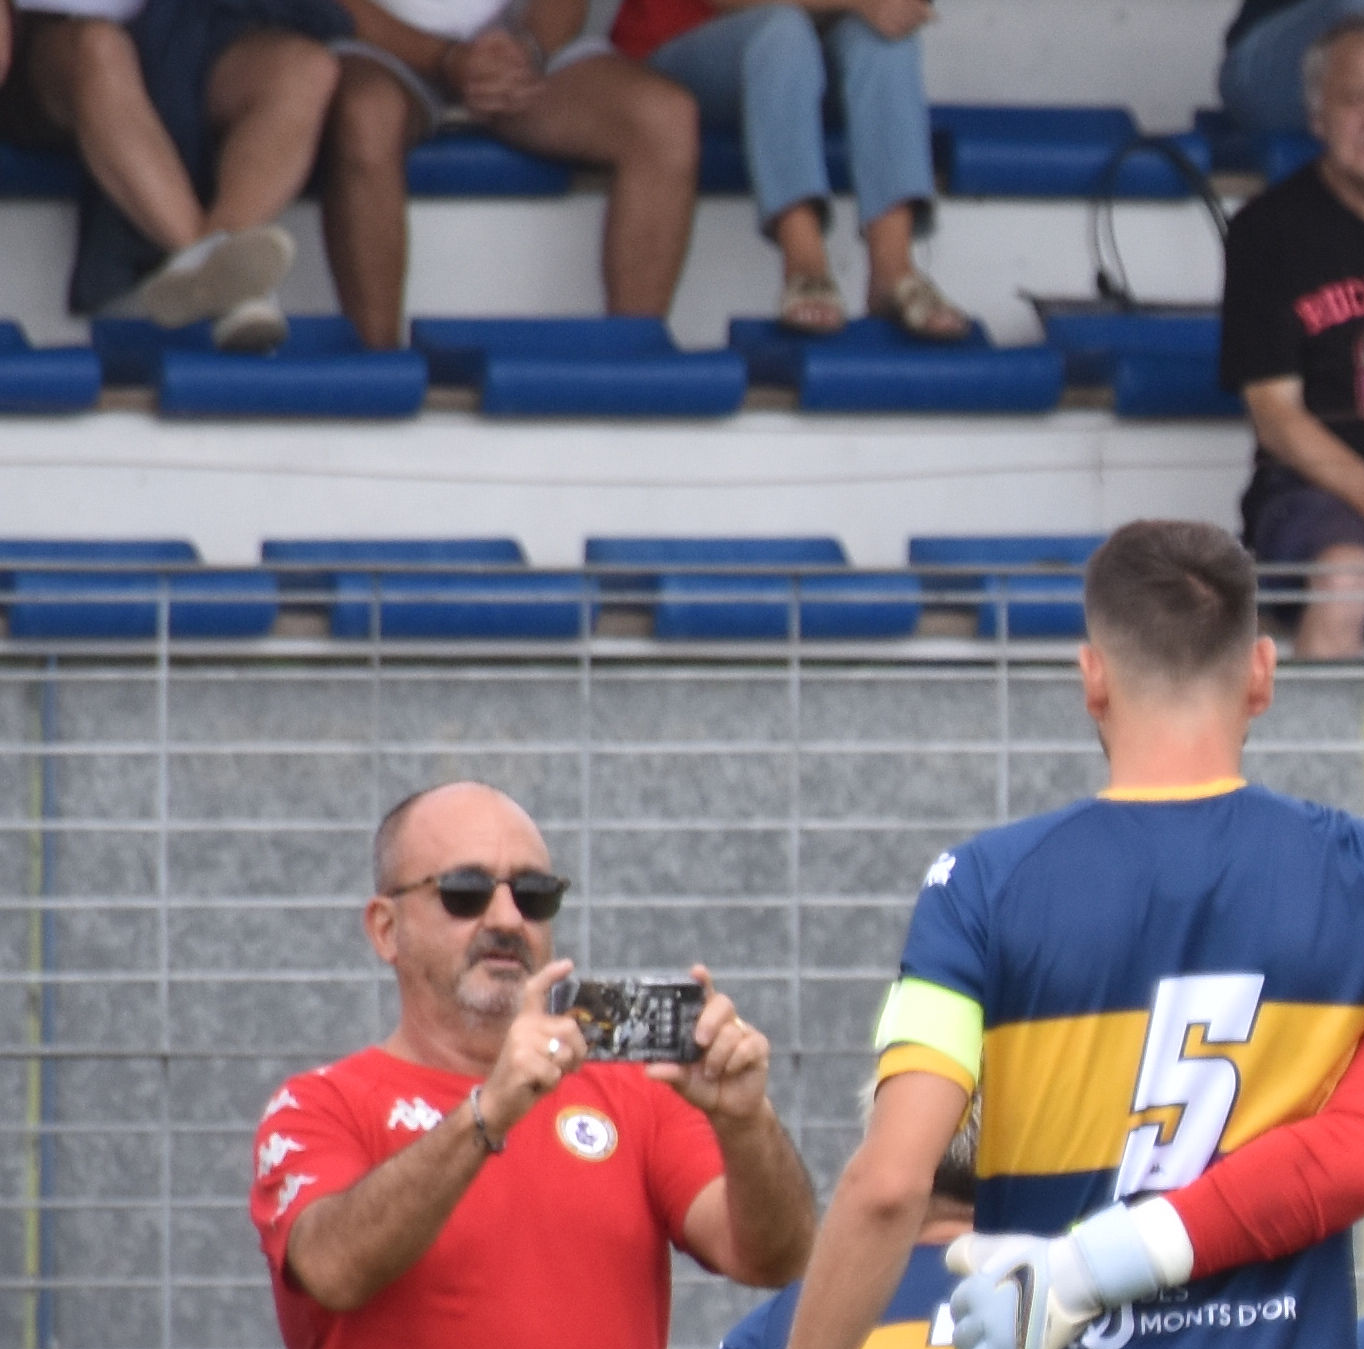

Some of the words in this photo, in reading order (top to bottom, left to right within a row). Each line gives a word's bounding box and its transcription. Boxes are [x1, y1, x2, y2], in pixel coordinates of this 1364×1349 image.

[1113, 972, 1265, 1202] 5
[1140, 1302, 1231, 1336] MONTS
[1238, 1295, 1298, 1327] D'OR
